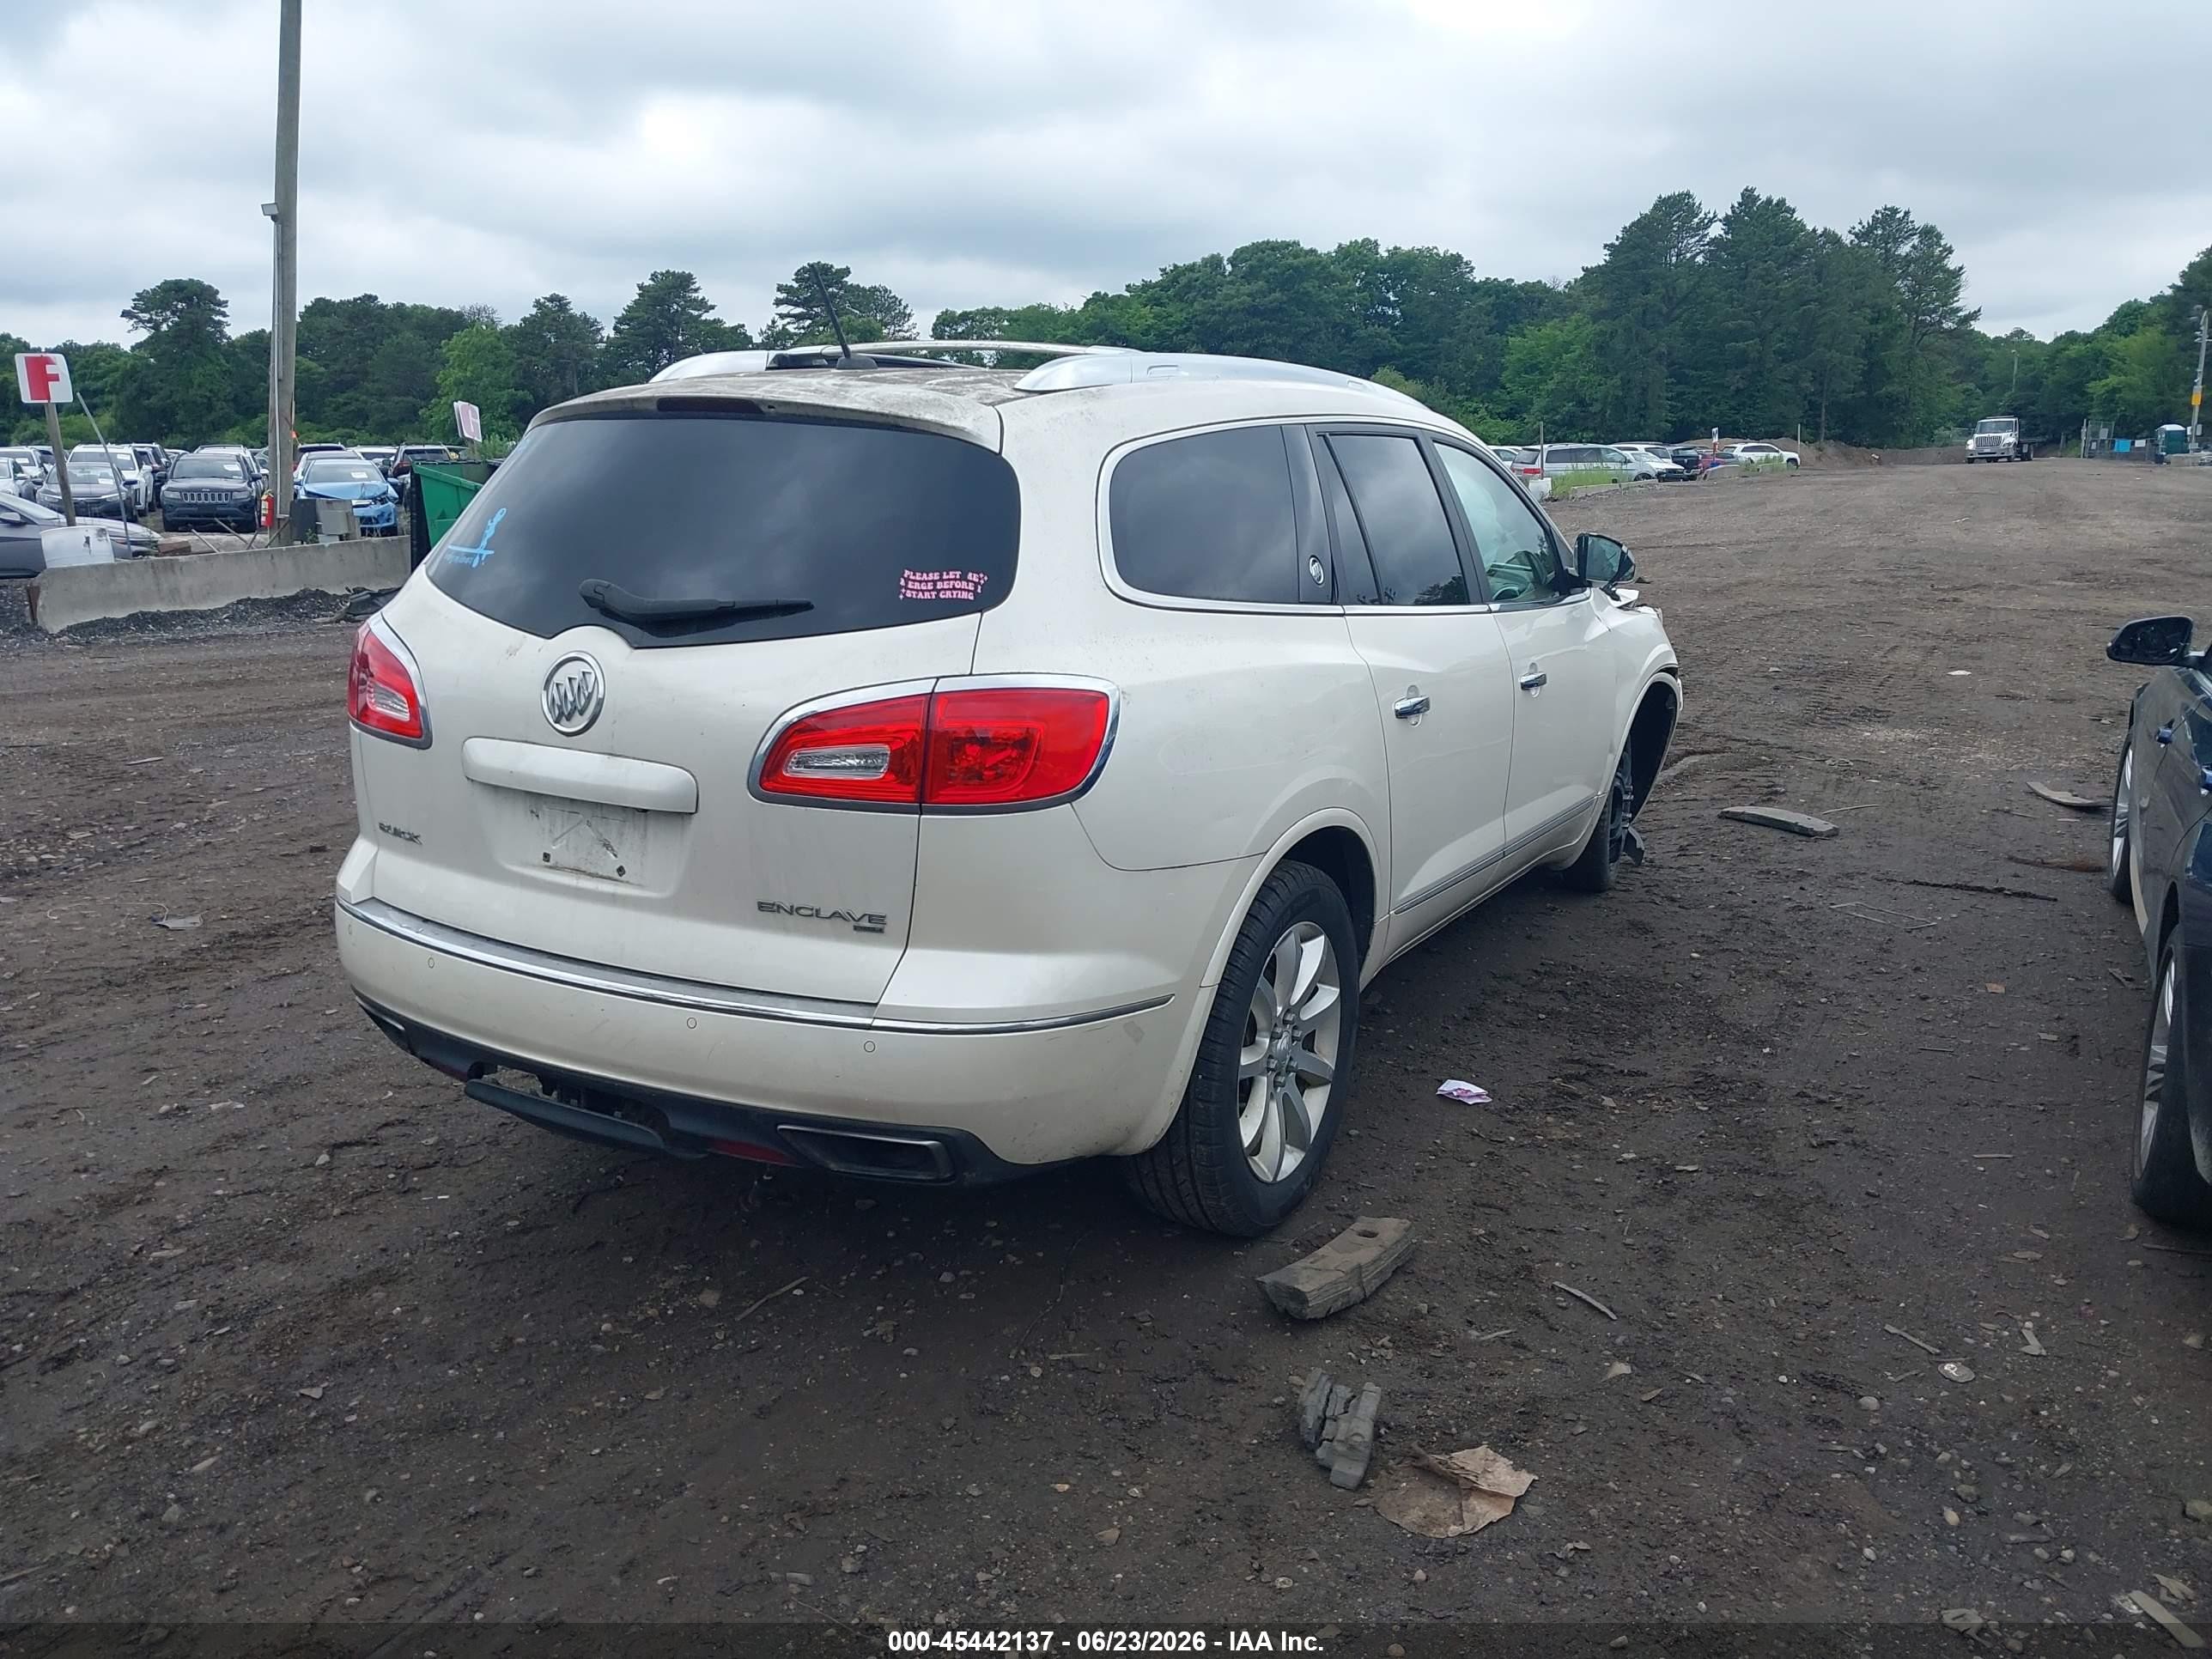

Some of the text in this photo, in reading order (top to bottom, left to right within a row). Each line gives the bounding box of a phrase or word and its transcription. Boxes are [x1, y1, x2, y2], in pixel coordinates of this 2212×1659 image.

[24, 356, 59, 400] F
[903, 569, 939, 580] PLEASE
[943, 571, 962, 580] LET
[936, 580, 975, 590] BEFORE
[905, 590, 975, 600] START CRYING
[757, 901, 886, 926] ENCLAVE
